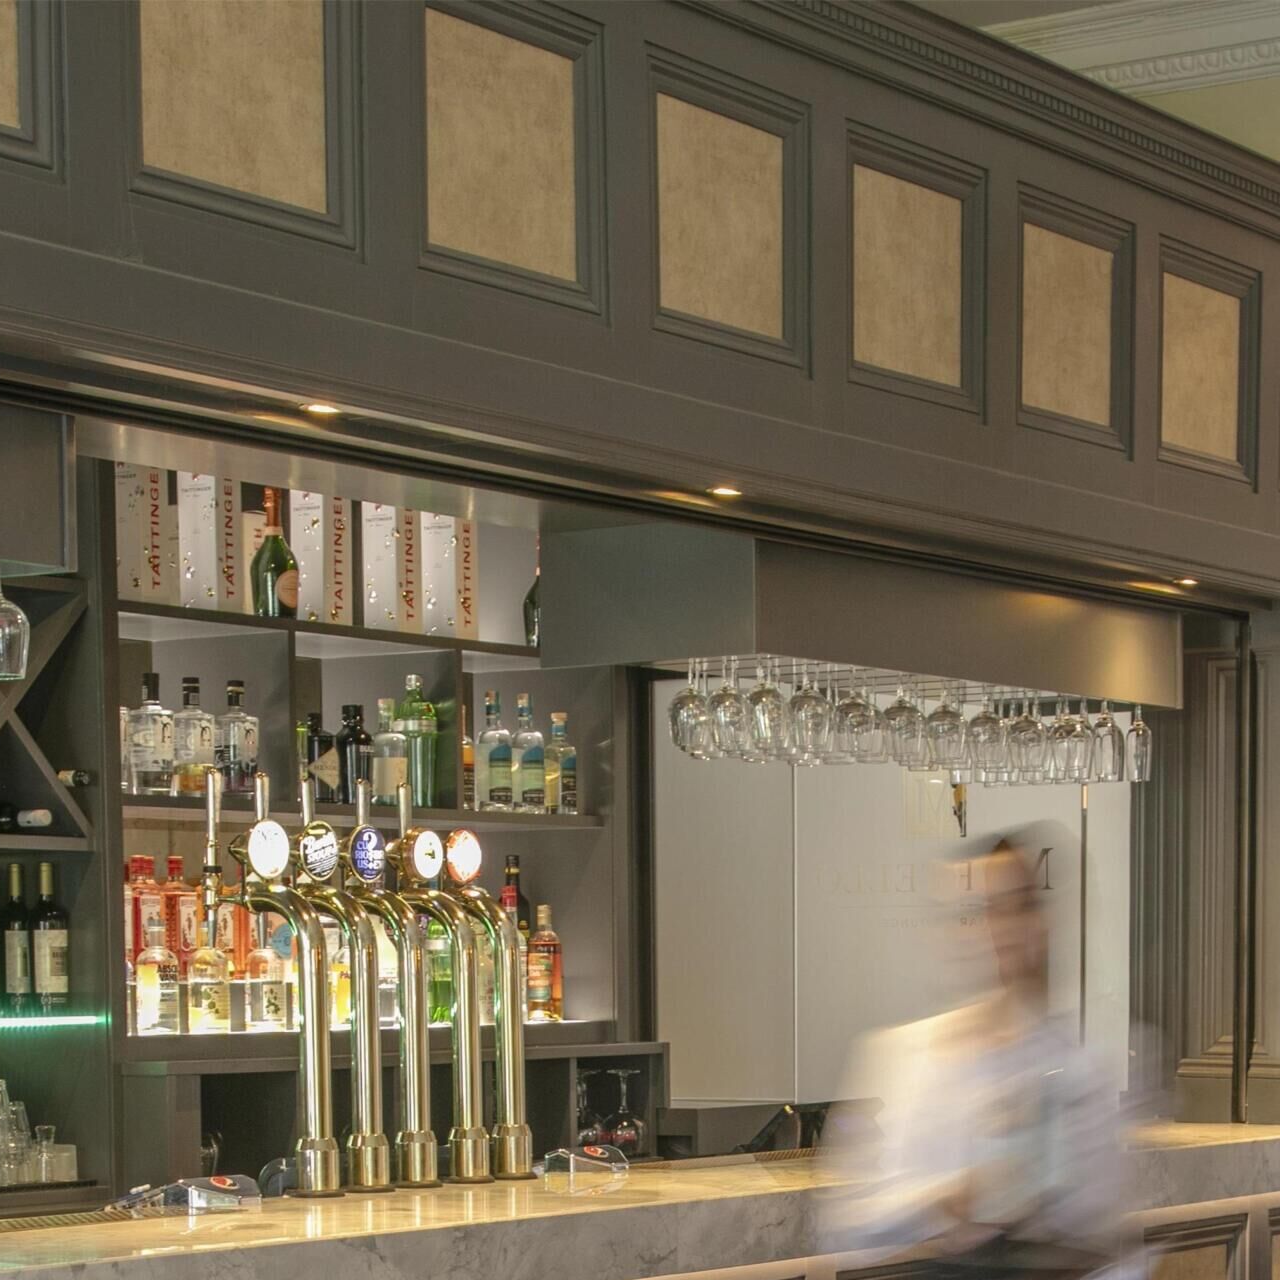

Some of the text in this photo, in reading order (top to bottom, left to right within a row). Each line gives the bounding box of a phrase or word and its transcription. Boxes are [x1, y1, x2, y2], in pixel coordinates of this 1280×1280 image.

[150, 471, 161, 590] TAITTINGE
[404, 508, 415, 621] TAITTINGE
[462, 523, 472, 628] TAITTINGE
